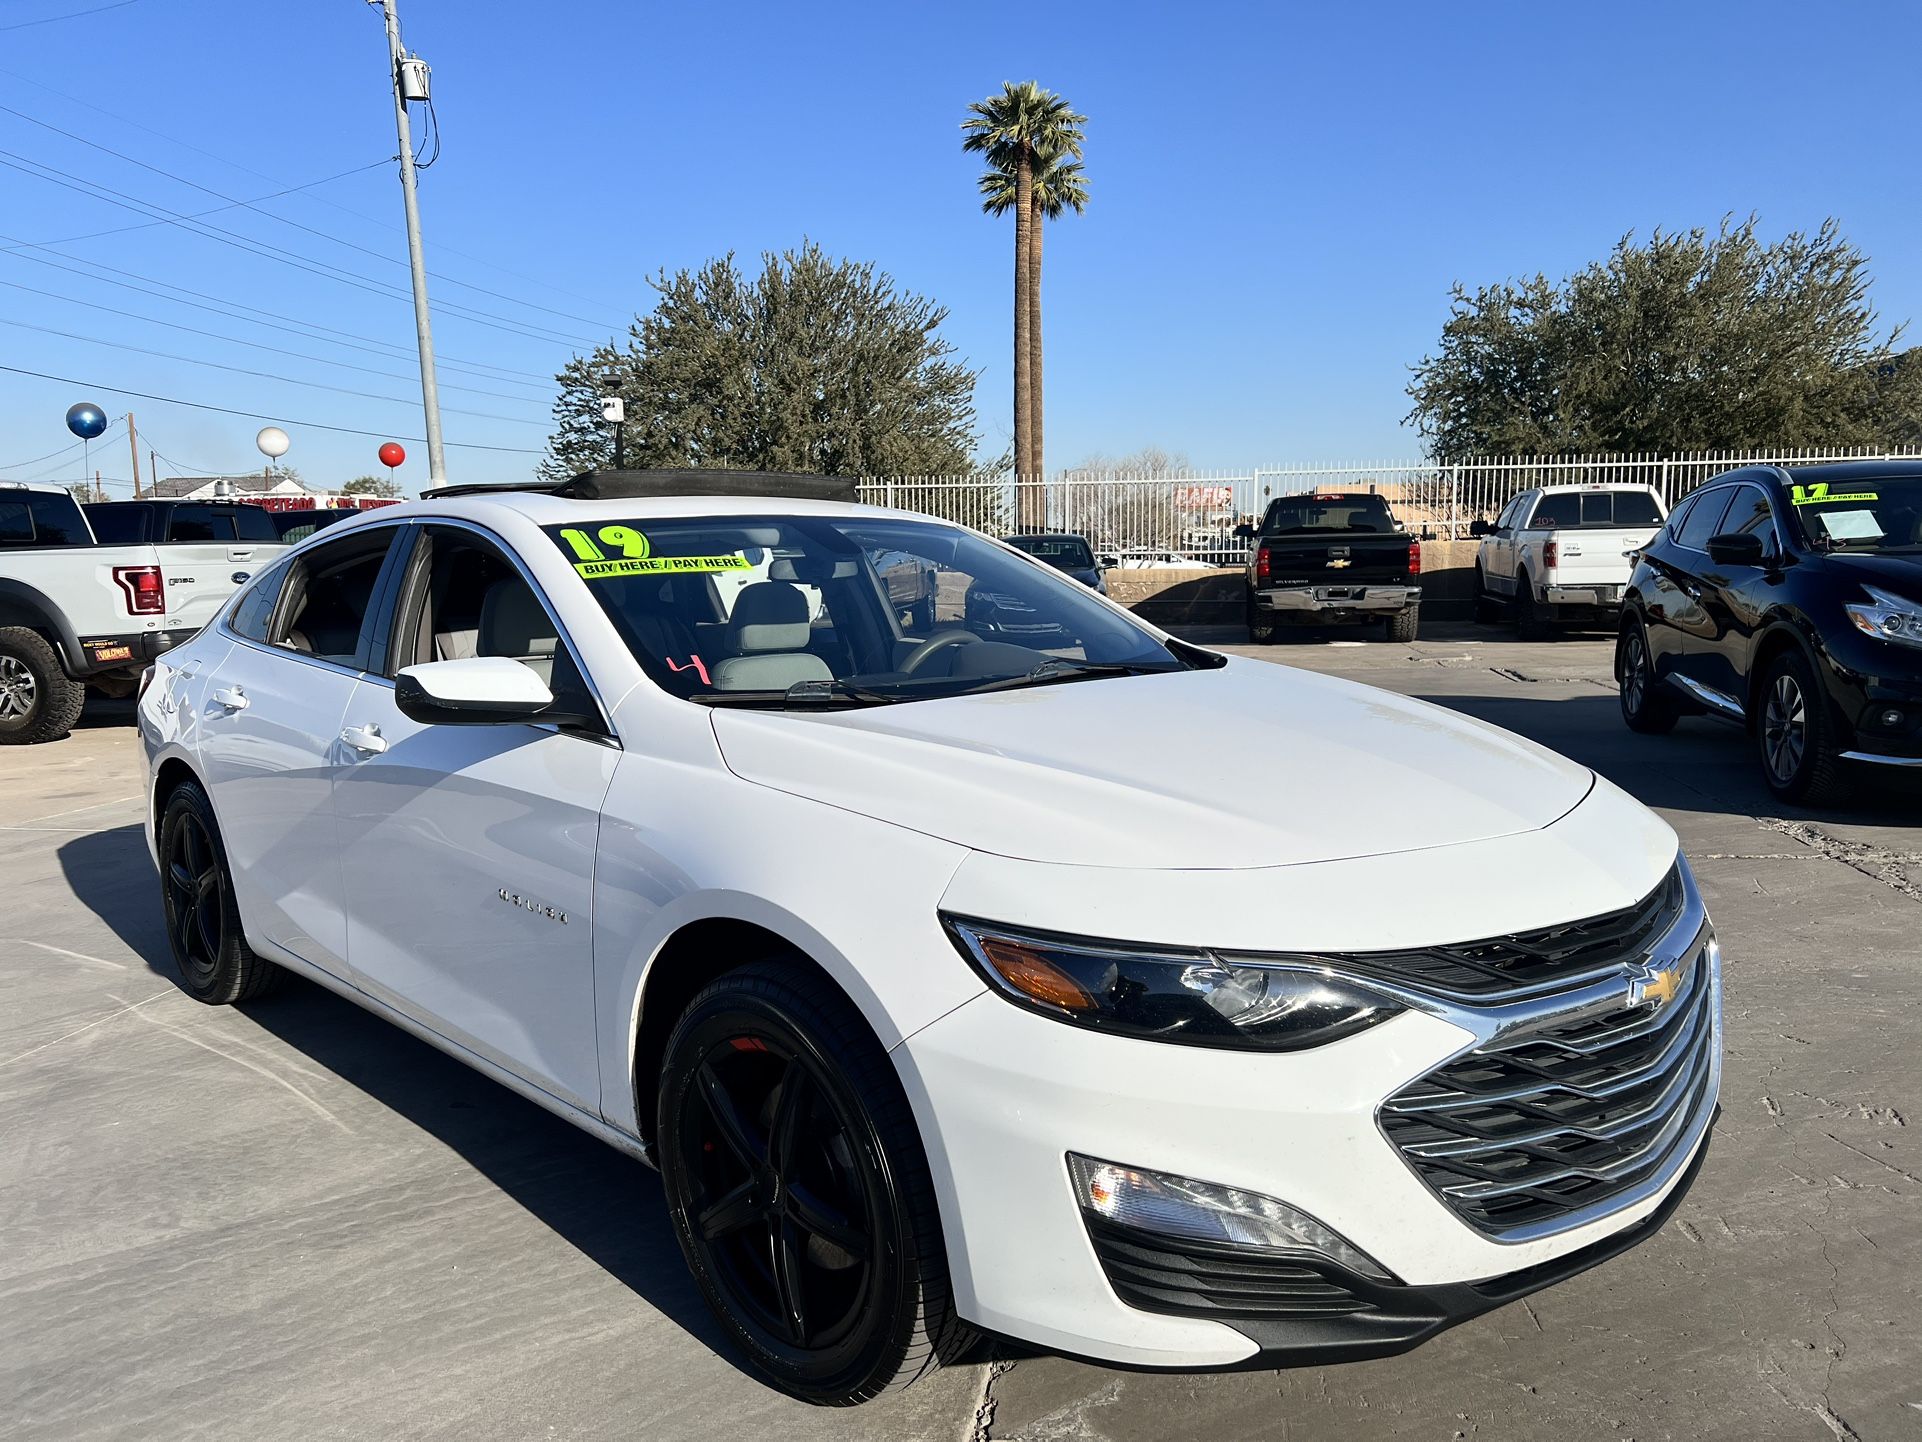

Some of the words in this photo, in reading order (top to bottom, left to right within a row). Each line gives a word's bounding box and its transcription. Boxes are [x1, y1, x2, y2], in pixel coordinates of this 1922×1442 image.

[1791, 483, 1829, 499] 17
[560, 525, 650, 560] 19
[584, 563, 615, 575] BUY
[619, 560, 660, 571] HERE
[673, 558, 702, 570] PAY
[704, 557, 742, 568] HERE
[665, 654, 712, 685] 4
[498, 887, 568, 925] MALIBU
